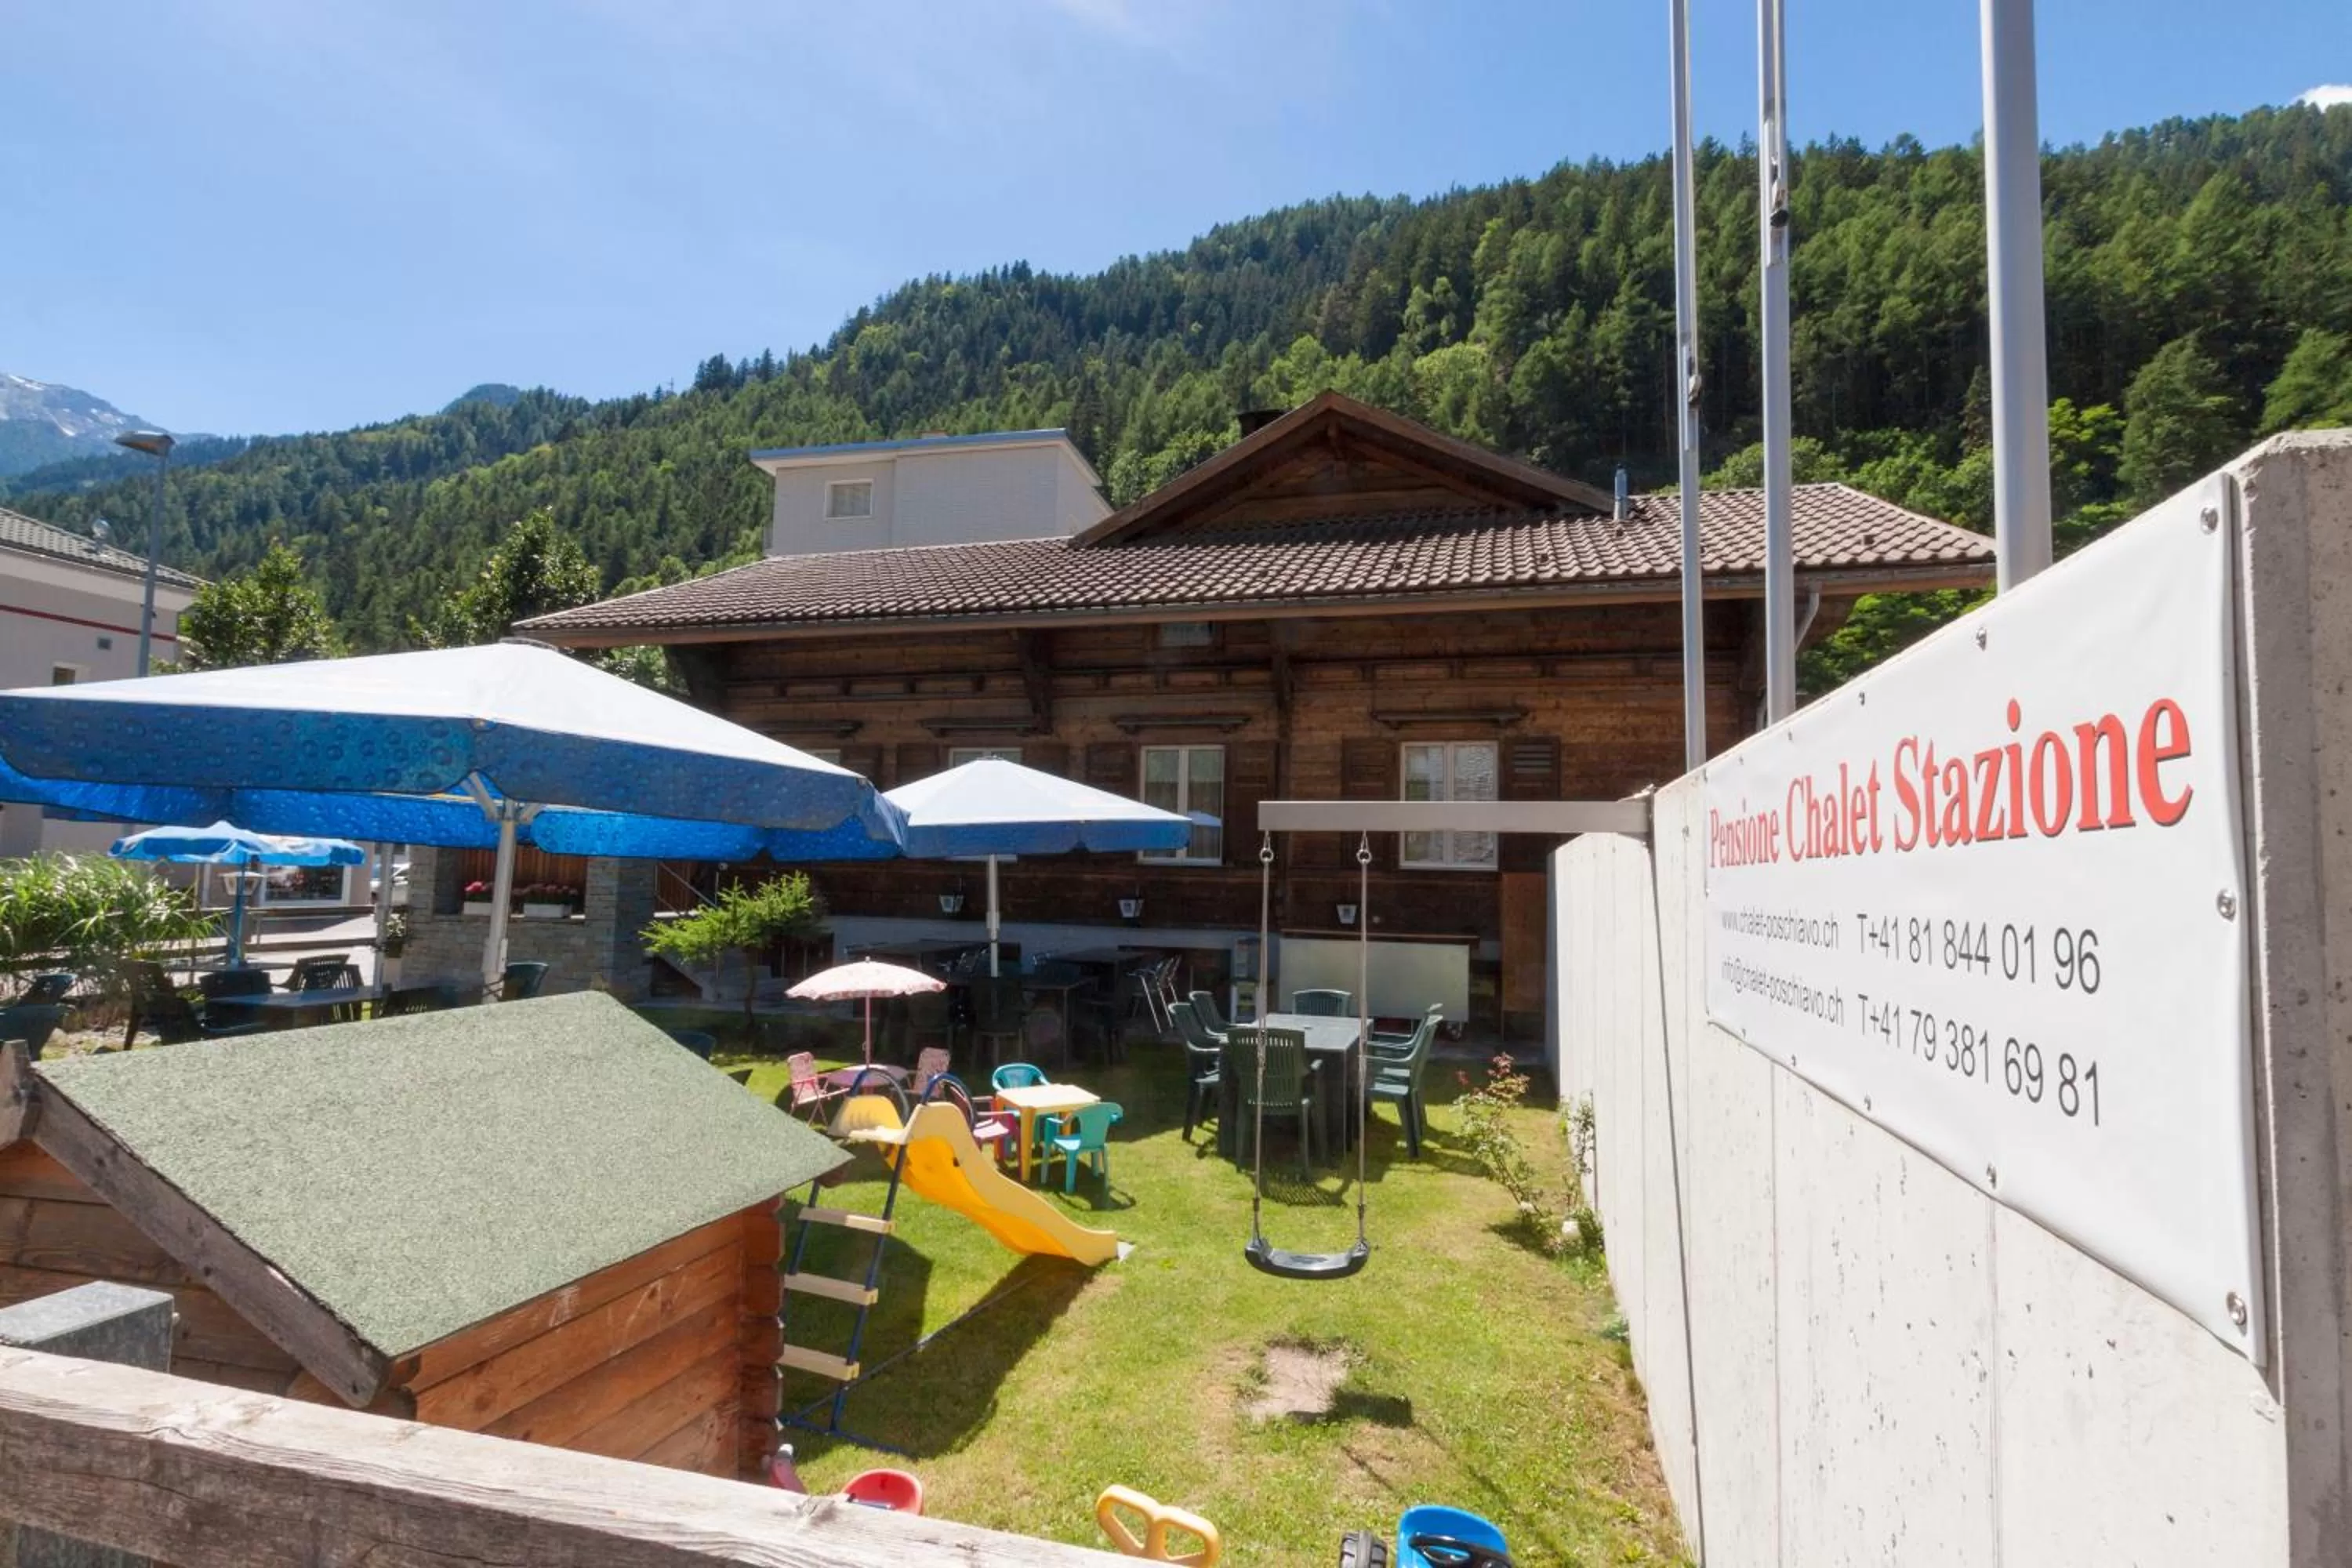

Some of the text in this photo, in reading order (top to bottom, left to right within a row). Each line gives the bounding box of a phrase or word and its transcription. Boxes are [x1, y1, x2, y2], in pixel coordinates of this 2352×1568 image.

[1710, 698, 2193, 867] Pensione Chalet Stazione
[1722, 907, 1838, 949] www.chalet-poschiavo.ch
[1909, 916, 1932, 965] 81
[1944, 920, 1991, 975] 844
[2002, 924, 2035, 983] 01
[2053, 927, 2101, 994] 96
[1911, 1009, 1936, 1061] 79
[1945, 1019, 1989, 1083] 381
[2004, 1037, 2044, 1103] 69
[2058, 1053, 2100, 1126] 81
